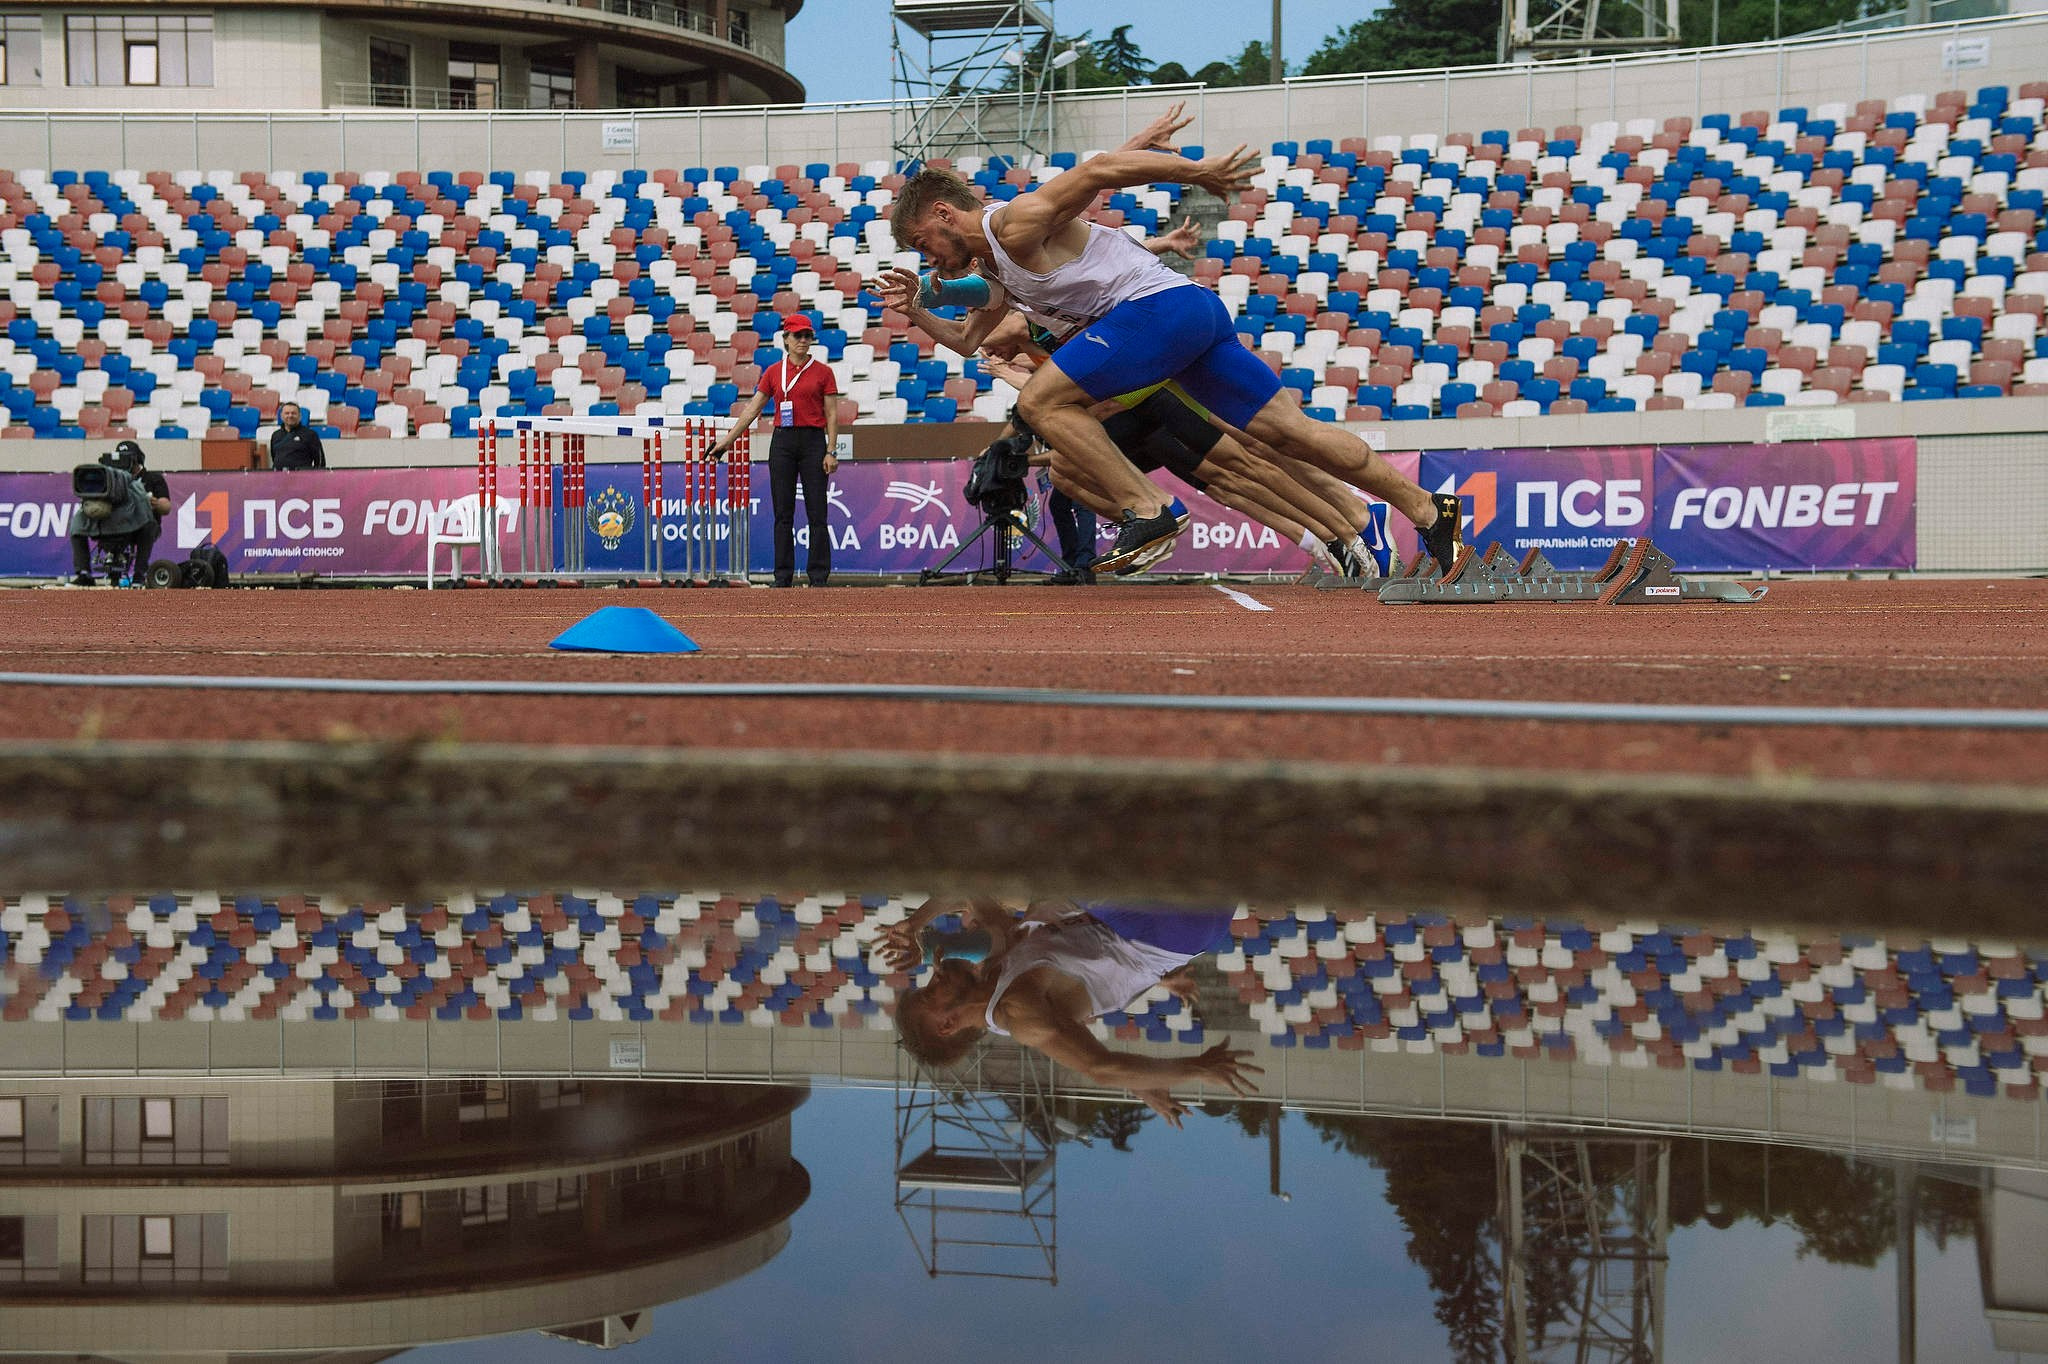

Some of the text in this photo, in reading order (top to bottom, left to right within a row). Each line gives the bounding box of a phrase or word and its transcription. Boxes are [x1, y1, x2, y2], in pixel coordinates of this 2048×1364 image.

[1516, 479, 1645, 528] ПСБ
[1669, 482, 1899, 530] FONBET
[244, 498, 344, 539] ПСБ
[792, 524, 861, 550] ФЛА
[880, 523, 960, 550] ВФЛА
[1192, 522, 1280, 549] ВФЛА
[1515, 536, 1587, 549] ГЕНЕРАЛЬНЫЙ
[244, 546, 345, 557] ГЕНЕРАЛЬНЫЙ СПОНСОР
